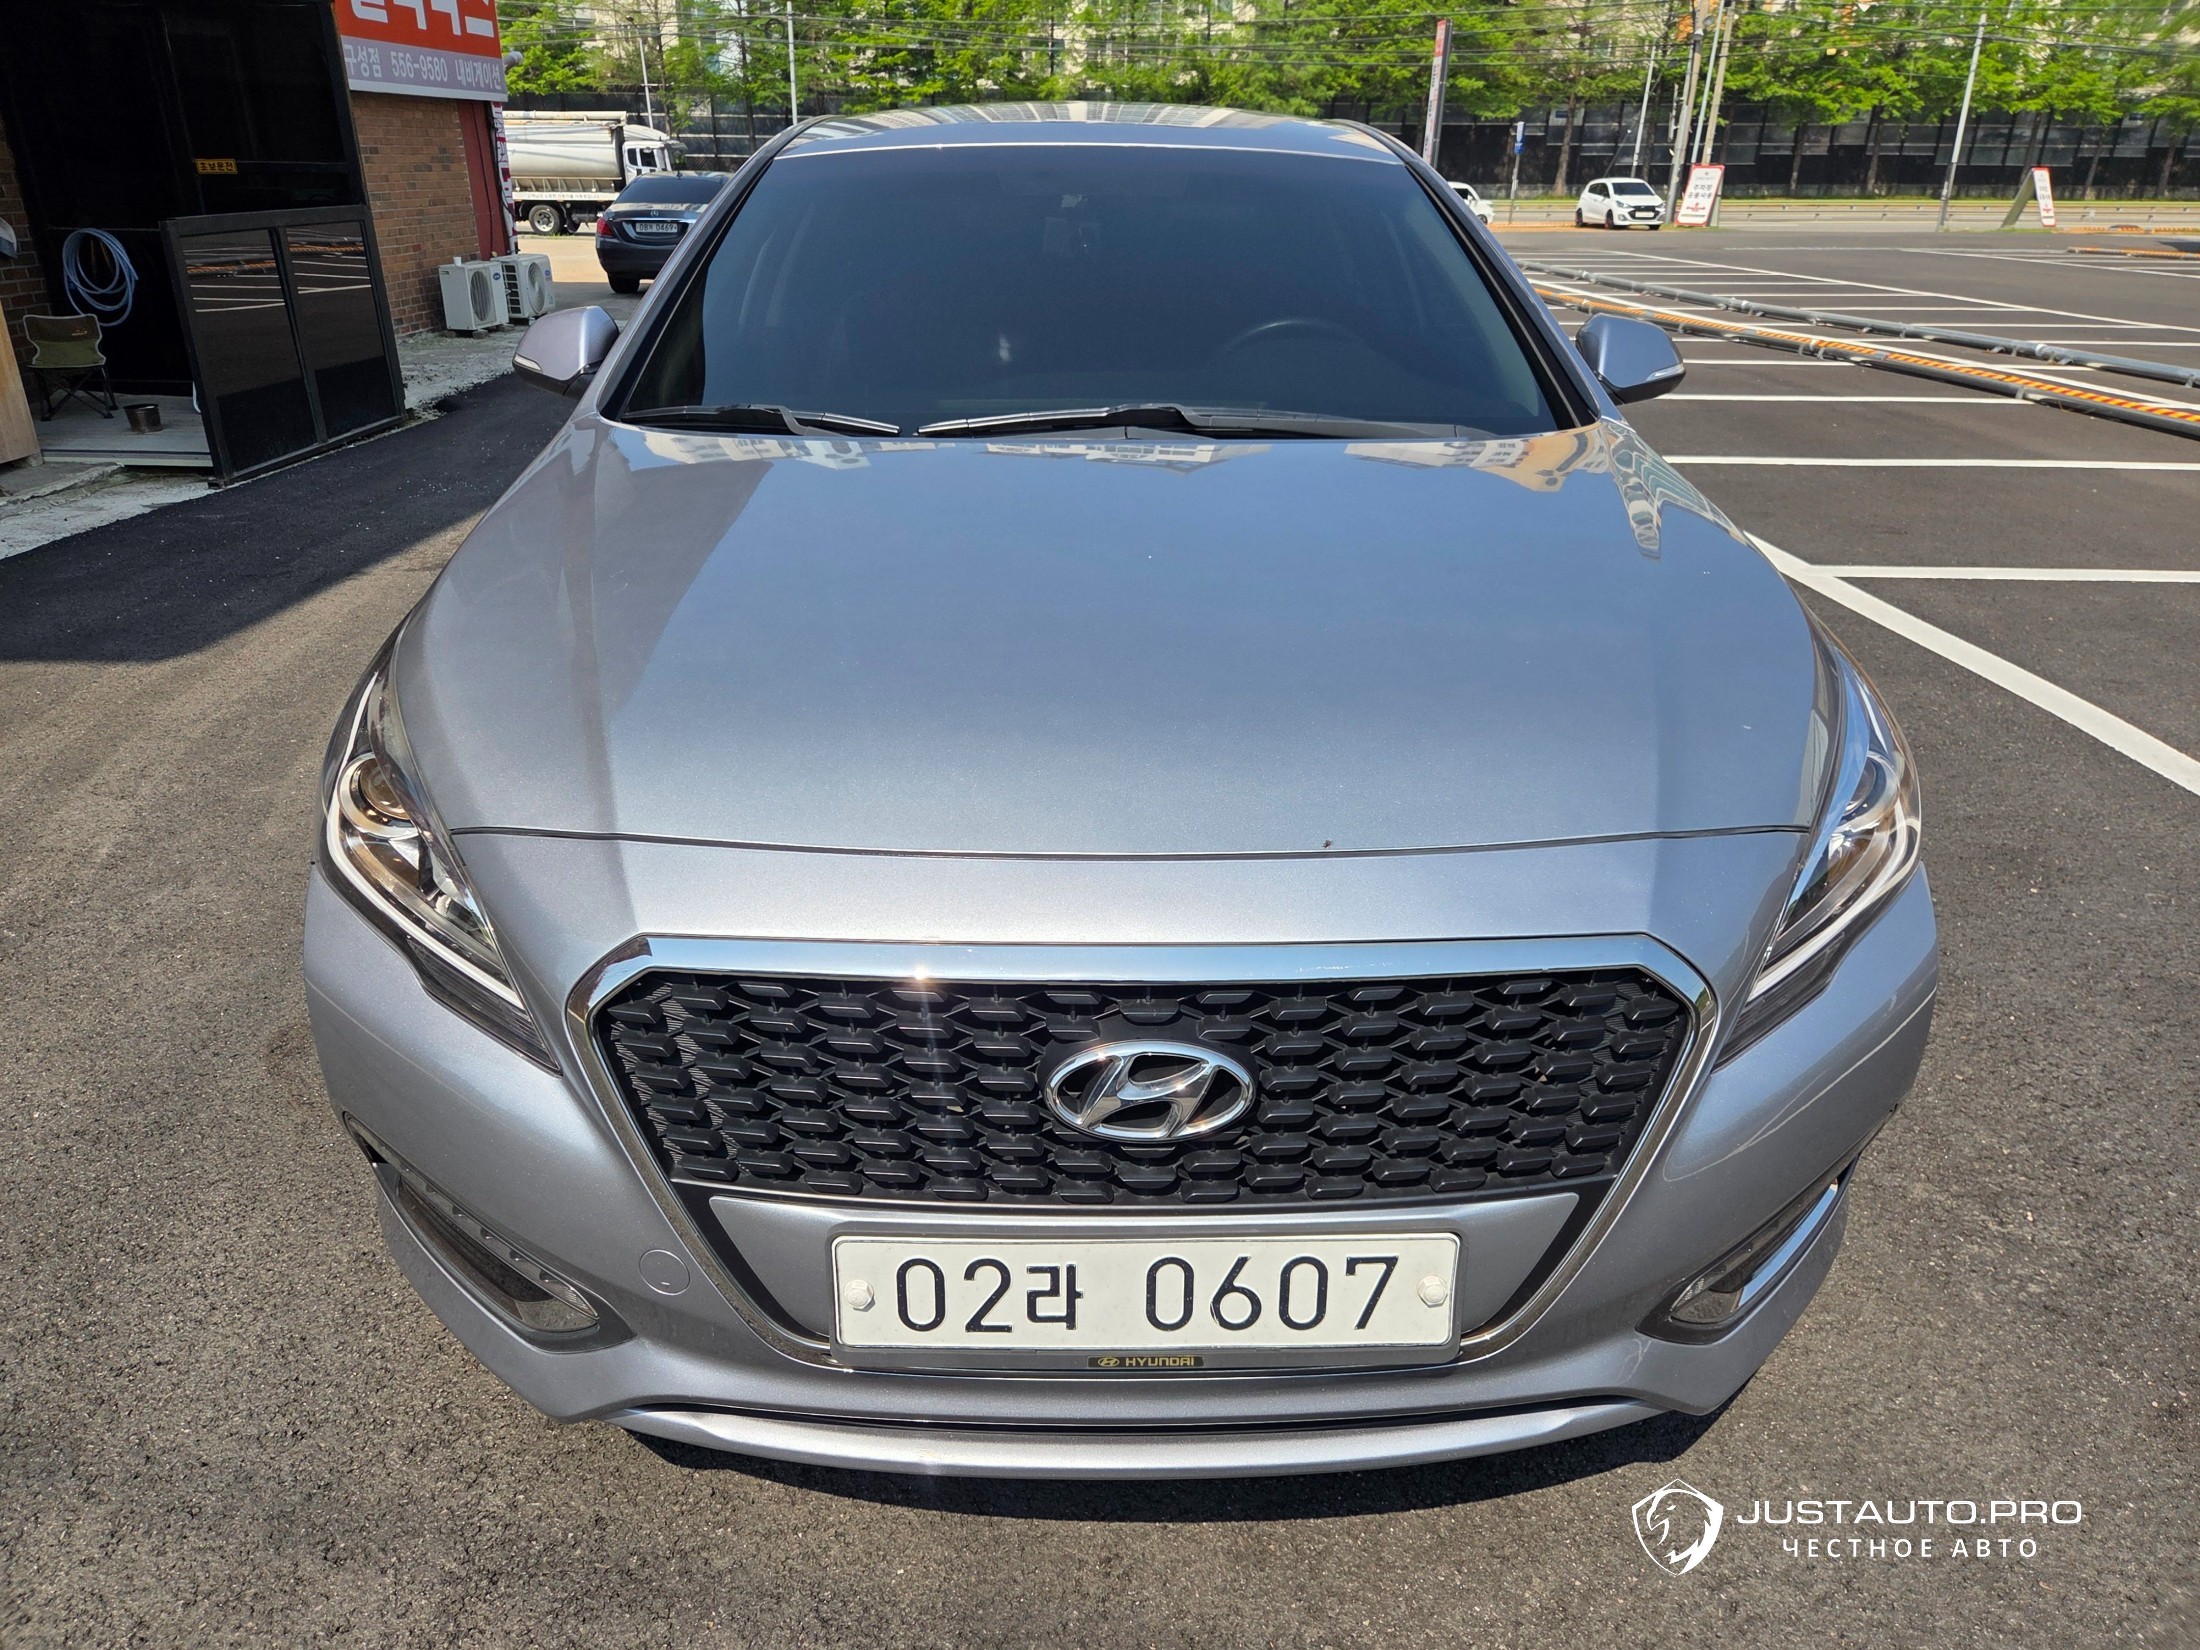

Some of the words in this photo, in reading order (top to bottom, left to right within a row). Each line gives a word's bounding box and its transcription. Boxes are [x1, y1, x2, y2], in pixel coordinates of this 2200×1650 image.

[343, 43, 383, 78] 구성점
[390, 51, 448, 82] 556-9580
[895, 1256, 1085, 1334] 02라
[1145, 1255, 1401, 1332] 0607
[1125, 1357, 1195, 1367] HYUNDAI
